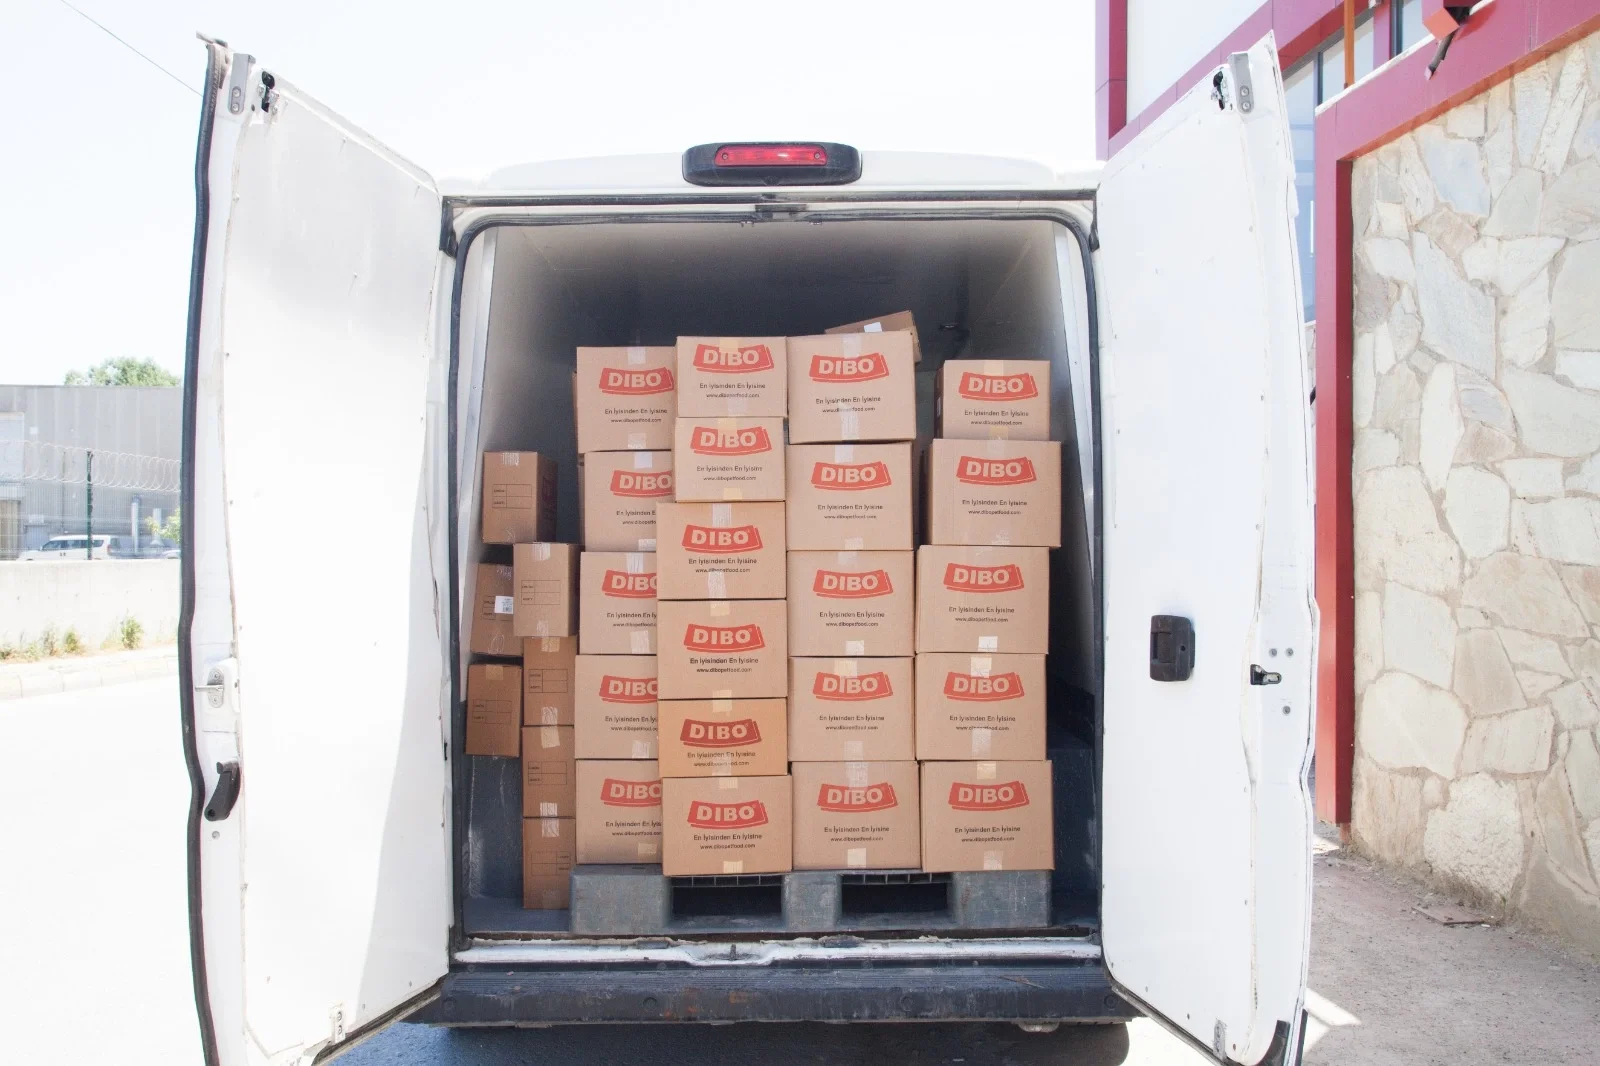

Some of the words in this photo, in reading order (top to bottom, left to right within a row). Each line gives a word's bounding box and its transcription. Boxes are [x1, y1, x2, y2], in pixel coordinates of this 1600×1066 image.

[703, 349, 761, 367] DIBO
[818, 358, 875, 376] DIBO
[607, 372, 662, 389] DIBO
[967, 376, 1025, 395] DIBO
[699, 431, 758, 449] DIBO
[820, 466, 878, 484] DIBO
[965, 460, 1023, 478] DIBO
[619, 474, 673, 491] DIBO
[690, 529, 750, 546] DIBO
[822, 574, 879, 592] DIBO
[952, 567, 1011, 586] DIBO
[692, 628, 752, 646] DIBO
[822, 677, 879, 695] DIBO
[952, 677, 1011, 695] DIBO
[689, 723, 748, 741] DIBO
[609, 783, 663, 800] DIBO
[826, 787, 884, 806] DIBO
[957, 786, 1015, 804] DIBO
[695, 805, 756, 822] DIBO
